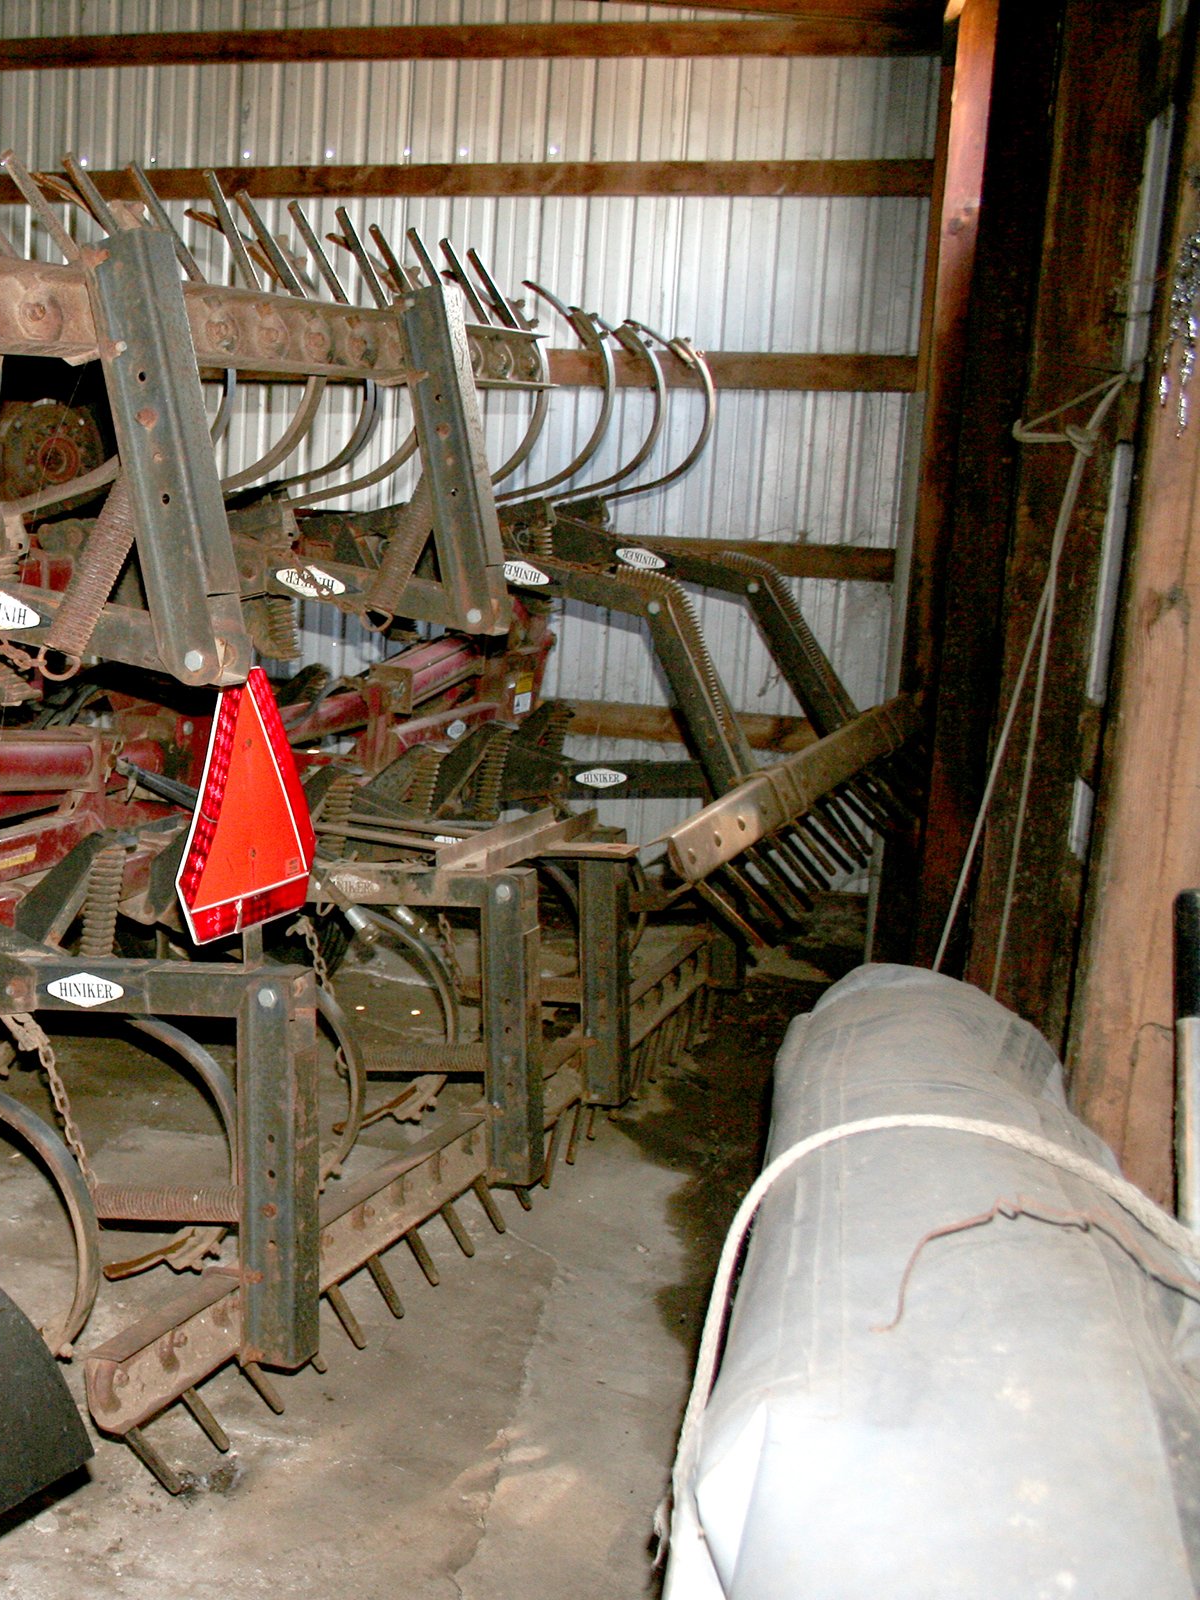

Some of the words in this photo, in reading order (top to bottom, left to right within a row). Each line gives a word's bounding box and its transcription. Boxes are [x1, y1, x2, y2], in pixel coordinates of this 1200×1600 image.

[623, 550, 658, 567] HINIKER
[286, 569, 335, 590] HIER
[583, 773, 620, 783] HINIKER
[58, 982, 113, 999] HINIKER
